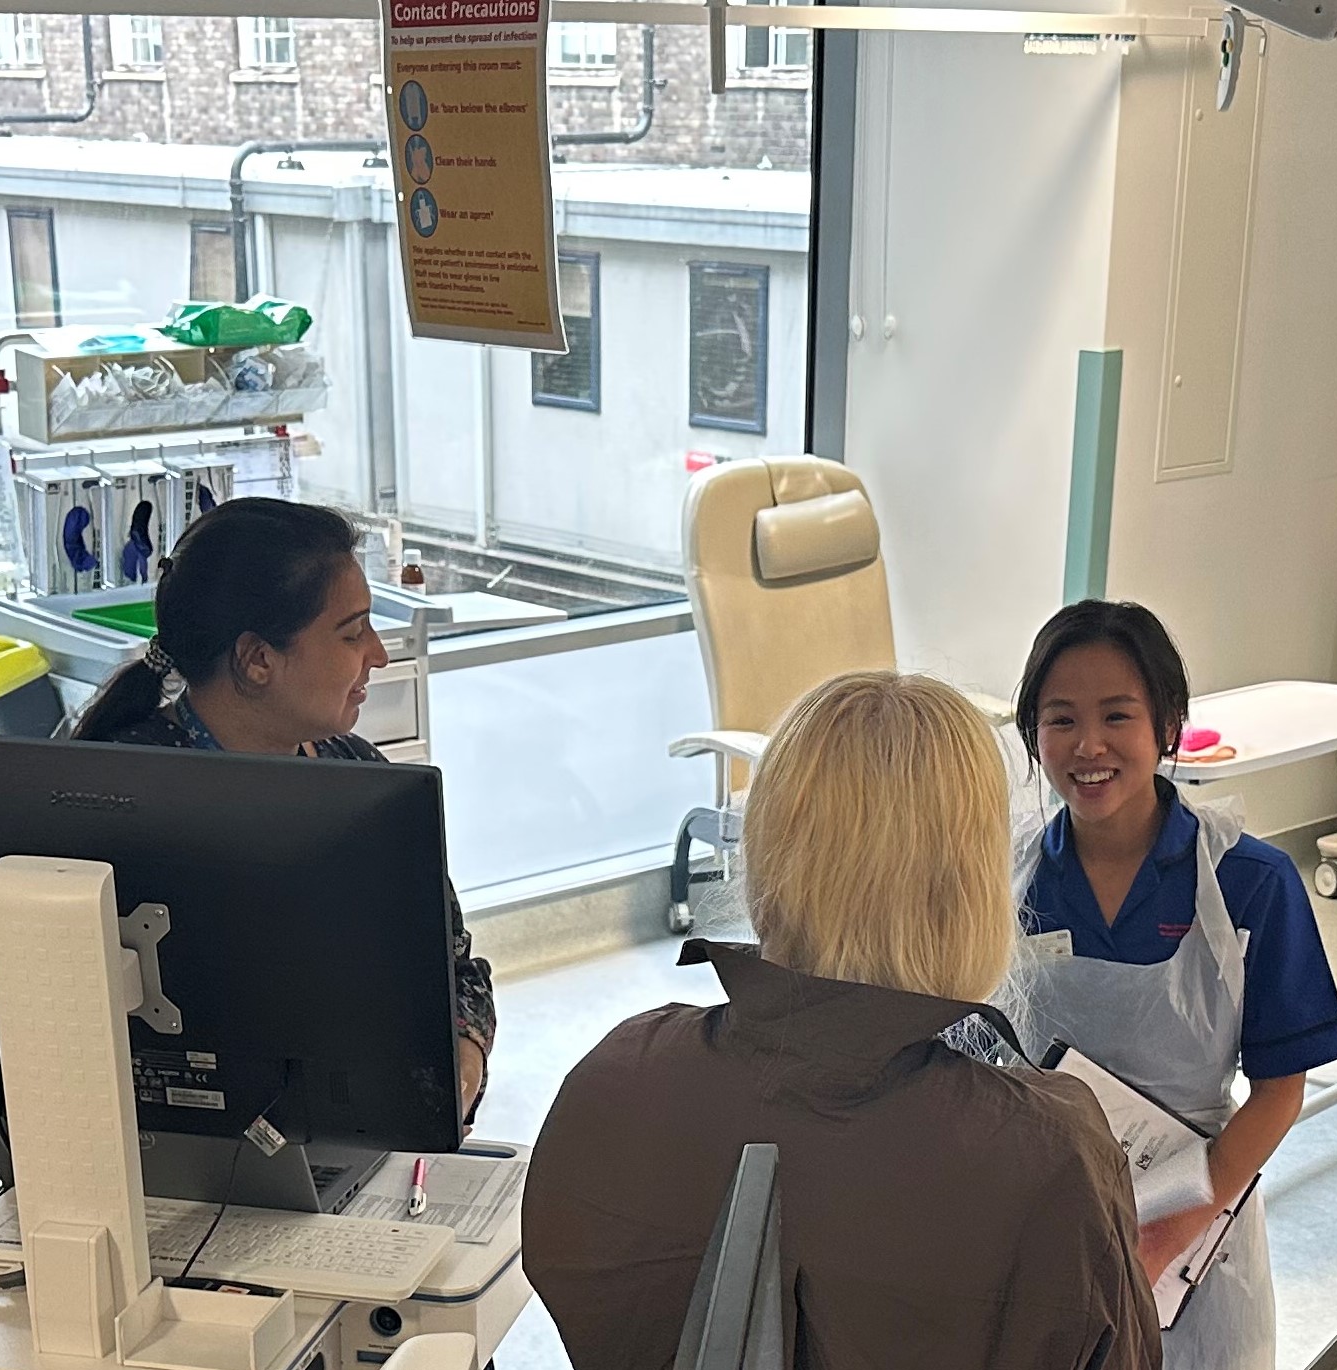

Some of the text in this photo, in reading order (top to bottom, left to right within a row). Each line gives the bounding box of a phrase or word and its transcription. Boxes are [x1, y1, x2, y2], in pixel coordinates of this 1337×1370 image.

[394, 0, 536, 22] Contact Precautions
[400, 35, 414, 46] help
[425, 35, 452, 46] prevent
[455, 33, 466, 43] the
[468, 32, 492, 44] spread
[494, 32, 502, 41] of
[503, 31, 537, 41] infection
[397, 62, 429, 75] Everyone
[430, 62, 461, 73] entering
[463, 60, 477, 71] this
[478, 63, 499, 71] room
[429, 103, 439, 113] Be
[461, 103, 483, 113] below
[485, 103, 497, 113] the
[435, 156, 496, 167] Clean their hands
[440, 208, 457, 218] Wear
[459, 211, 468, 219] an
[444, 247, 466, 256] whether
